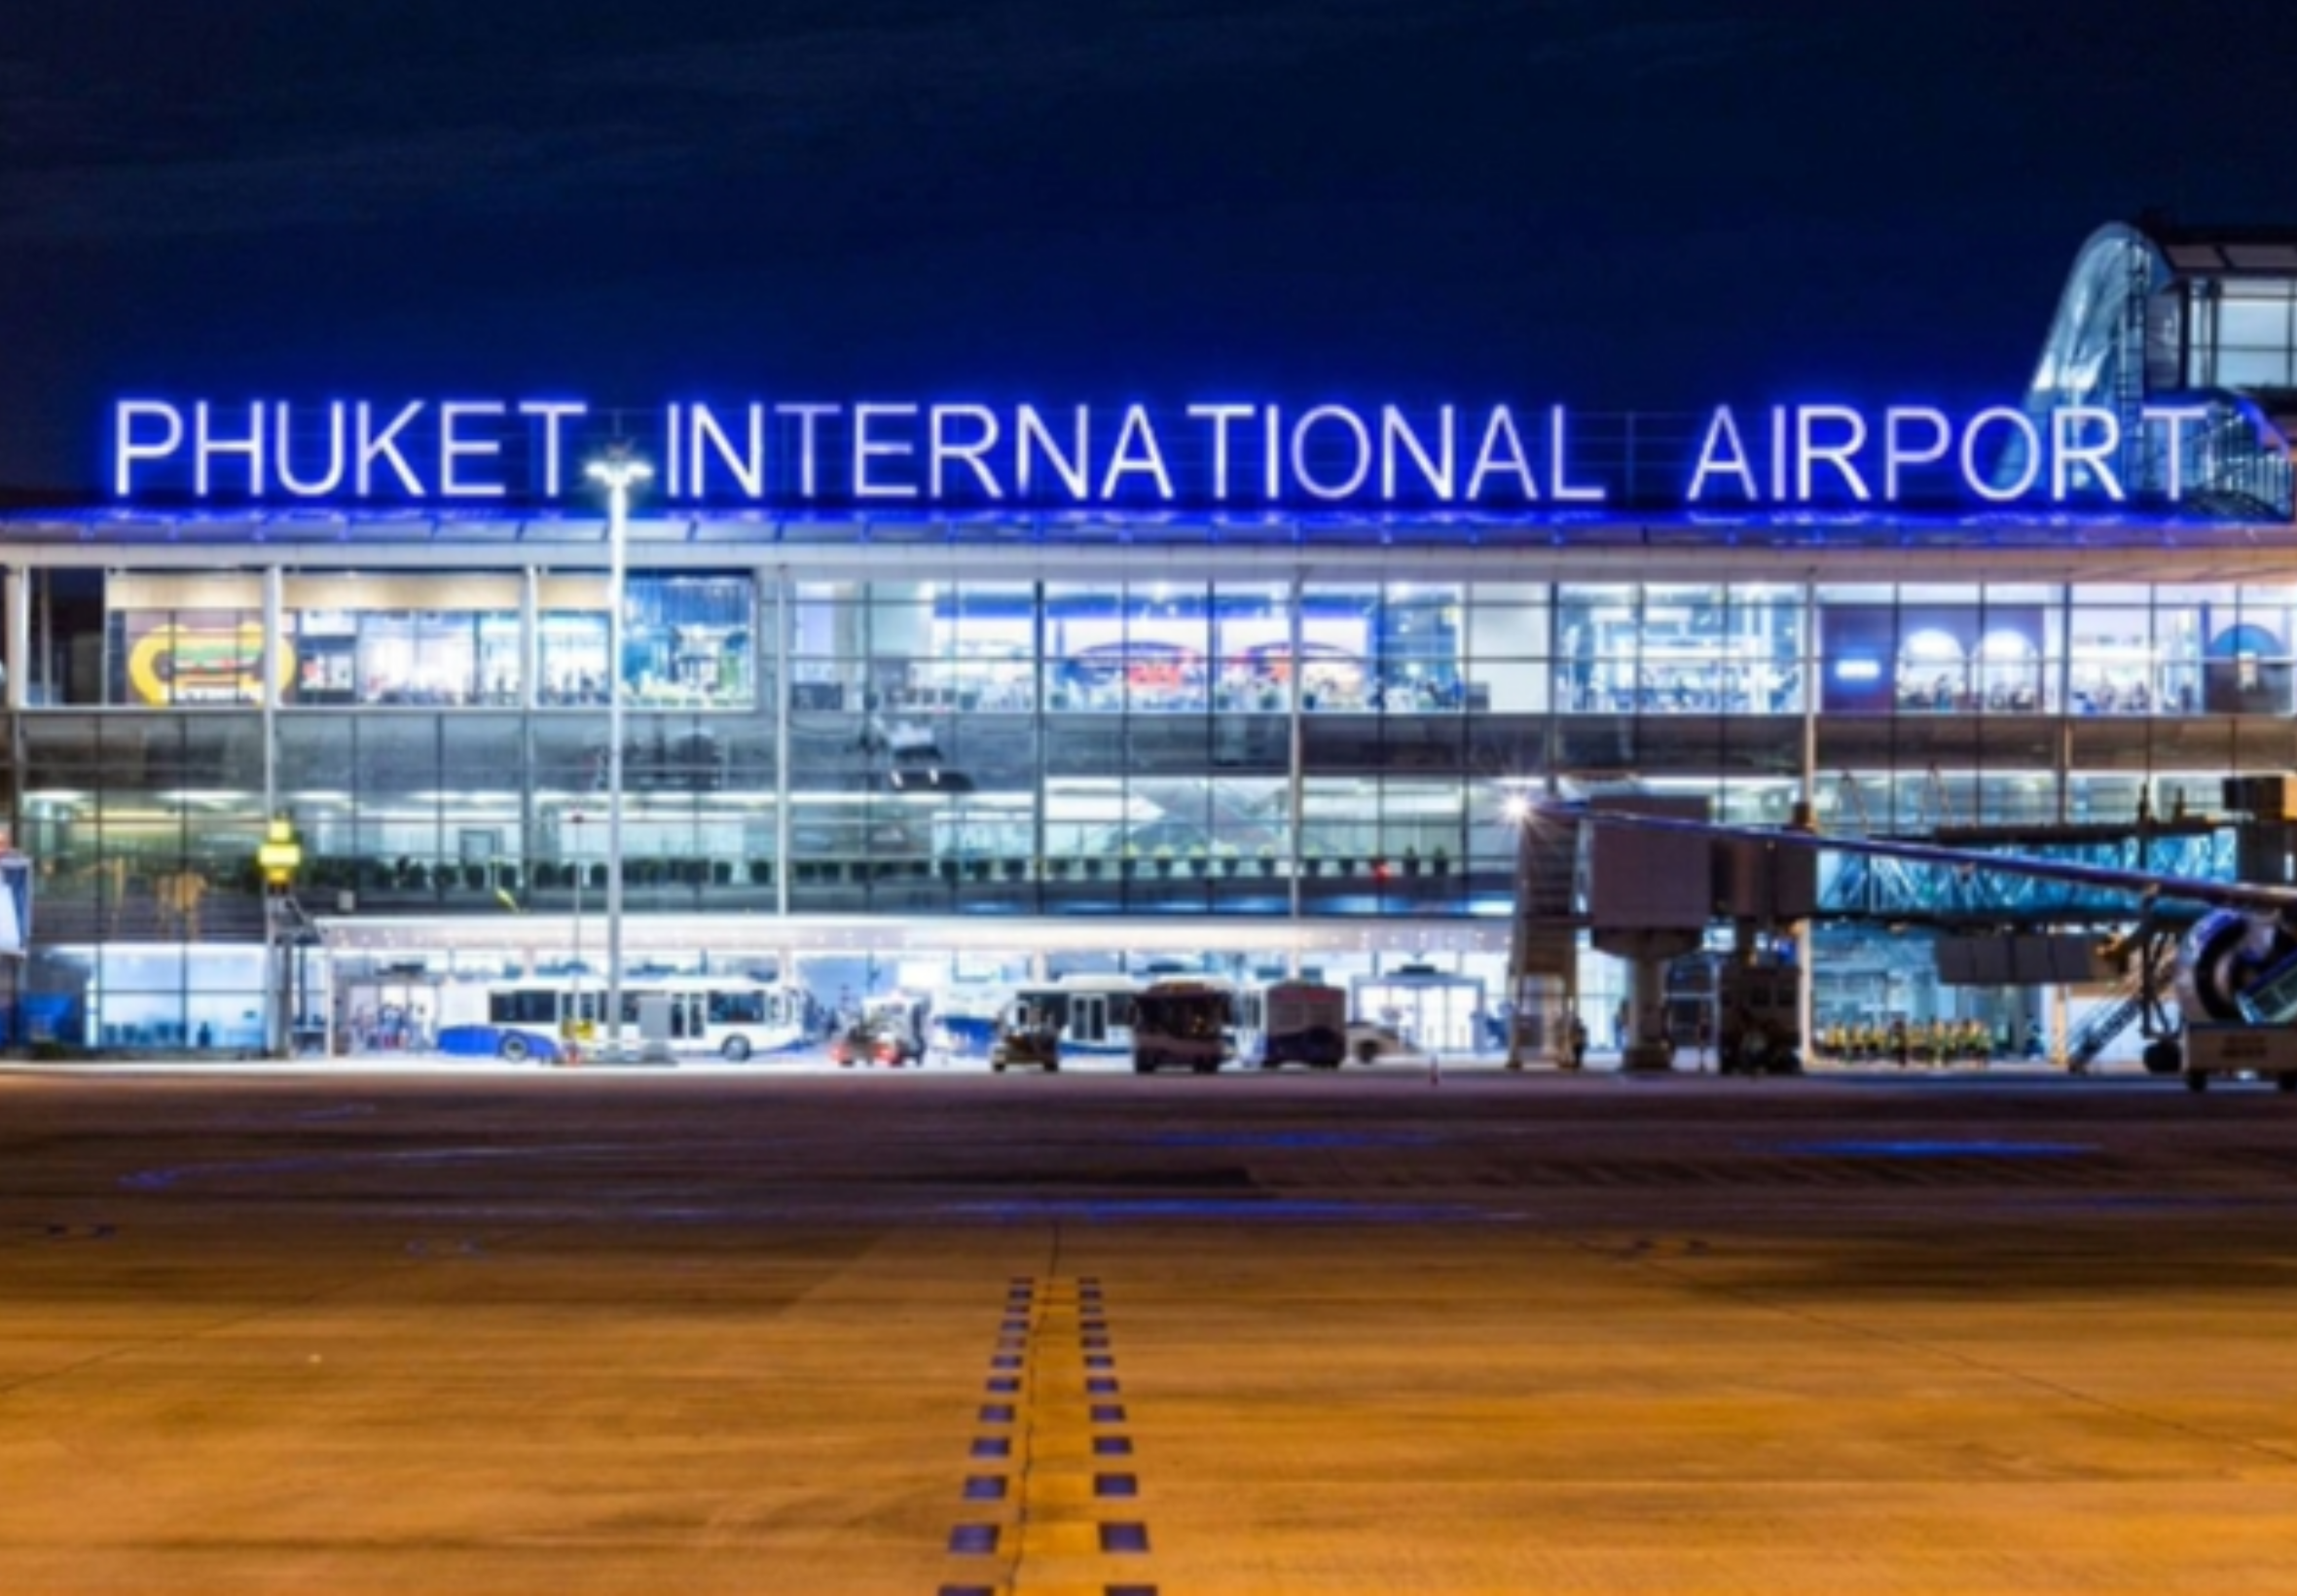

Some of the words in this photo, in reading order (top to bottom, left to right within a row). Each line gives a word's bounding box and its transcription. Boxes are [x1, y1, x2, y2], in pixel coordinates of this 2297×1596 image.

[114, 400, 588, 498] PHUKET
[666, 403, 1606, 499] INTERNATIONAL
[1687, 404, 2207, 500] AIRPORT
